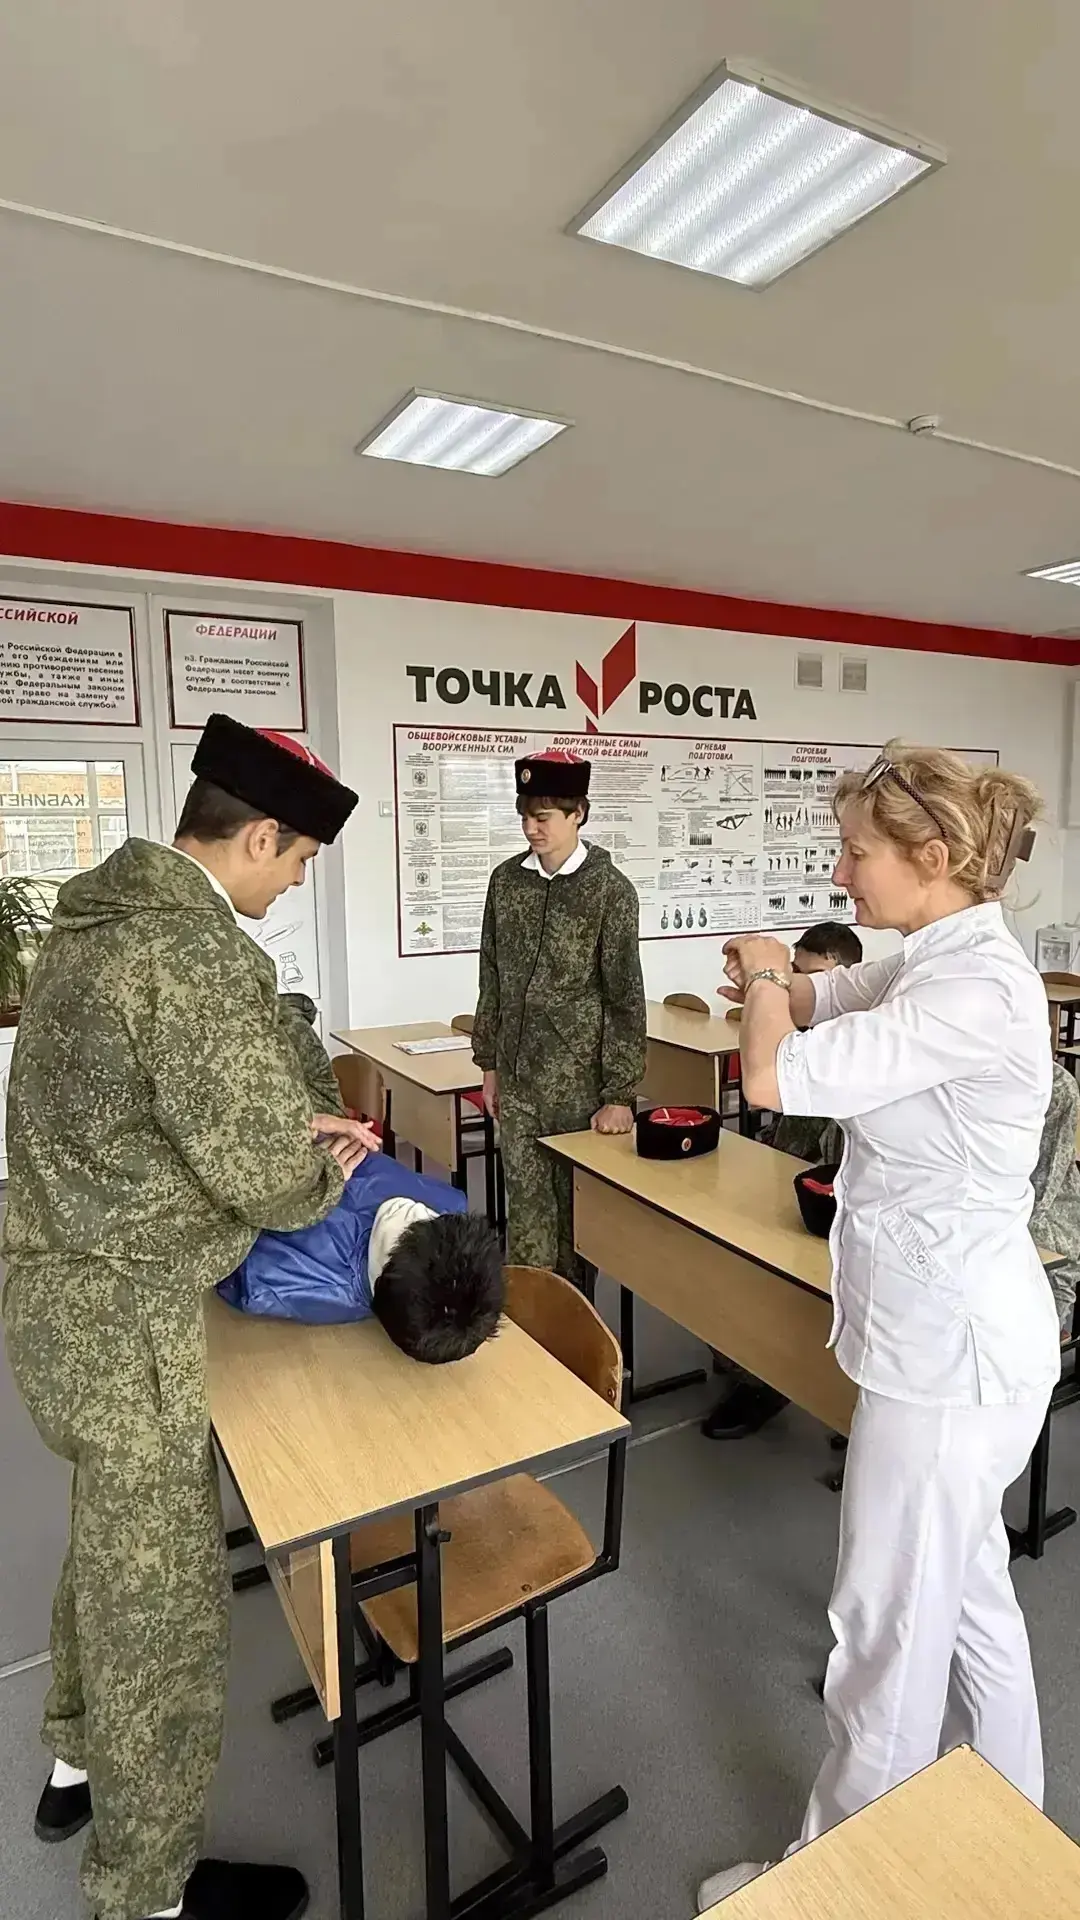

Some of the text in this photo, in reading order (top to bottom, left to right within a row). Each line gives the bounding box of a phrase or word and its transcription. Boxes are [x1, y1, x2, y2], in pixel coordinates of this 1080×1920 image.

[195, 624, 278, 640] ФЕДЕРАЦИИ
[8, 642, 62, 653] Российской
[65, 647, 115, 656] Федерации
[36, 654, 99, 664] убеждениям
[199, 655, 243, 664] Гражданин
[245, 658, 289, 668] Российской
[23, 663, 86, 673] противоречит
[88, 667, 124, 675] несение
[185, 664, 231, 674] Федерации
[51, 673, 81, 681] также
[185, 676, 215, 684] службу
[231, 678, 281, 687] соответствии
[15, 679, 81, 690] Федеральным
[87, 684, 125, 692] законом
[186, 684, 242, 694] Федеральным
[22, 689, 51, 697] право
[76, 692, 109, 701] замену
[406, 665, 757, 720] ТОЧКА РОСТА
[16, 698, 76, 706] гражданской
[407, 731, 527, 744] ОБЩЕВОЙСКОВЫЕ УСТАВЫ
[553, 737, 641, 748] ВООРУЖЕННЫЕ СИЛЫ
[422, 742, 515, 753] ВООРУЖЕННЫХ СИЛ
[695, 743, 727, 751] ОГНЕВАЯ
[795, 747, 828, 755] СТРОЕВАЯ
[600, 748, 649, 758] ФЕДЕРАЦИИ
[688, 751, 733, 761] ПОДГОТОВКА
[791, 755, 832, 764] ПОДГОТОВКА
